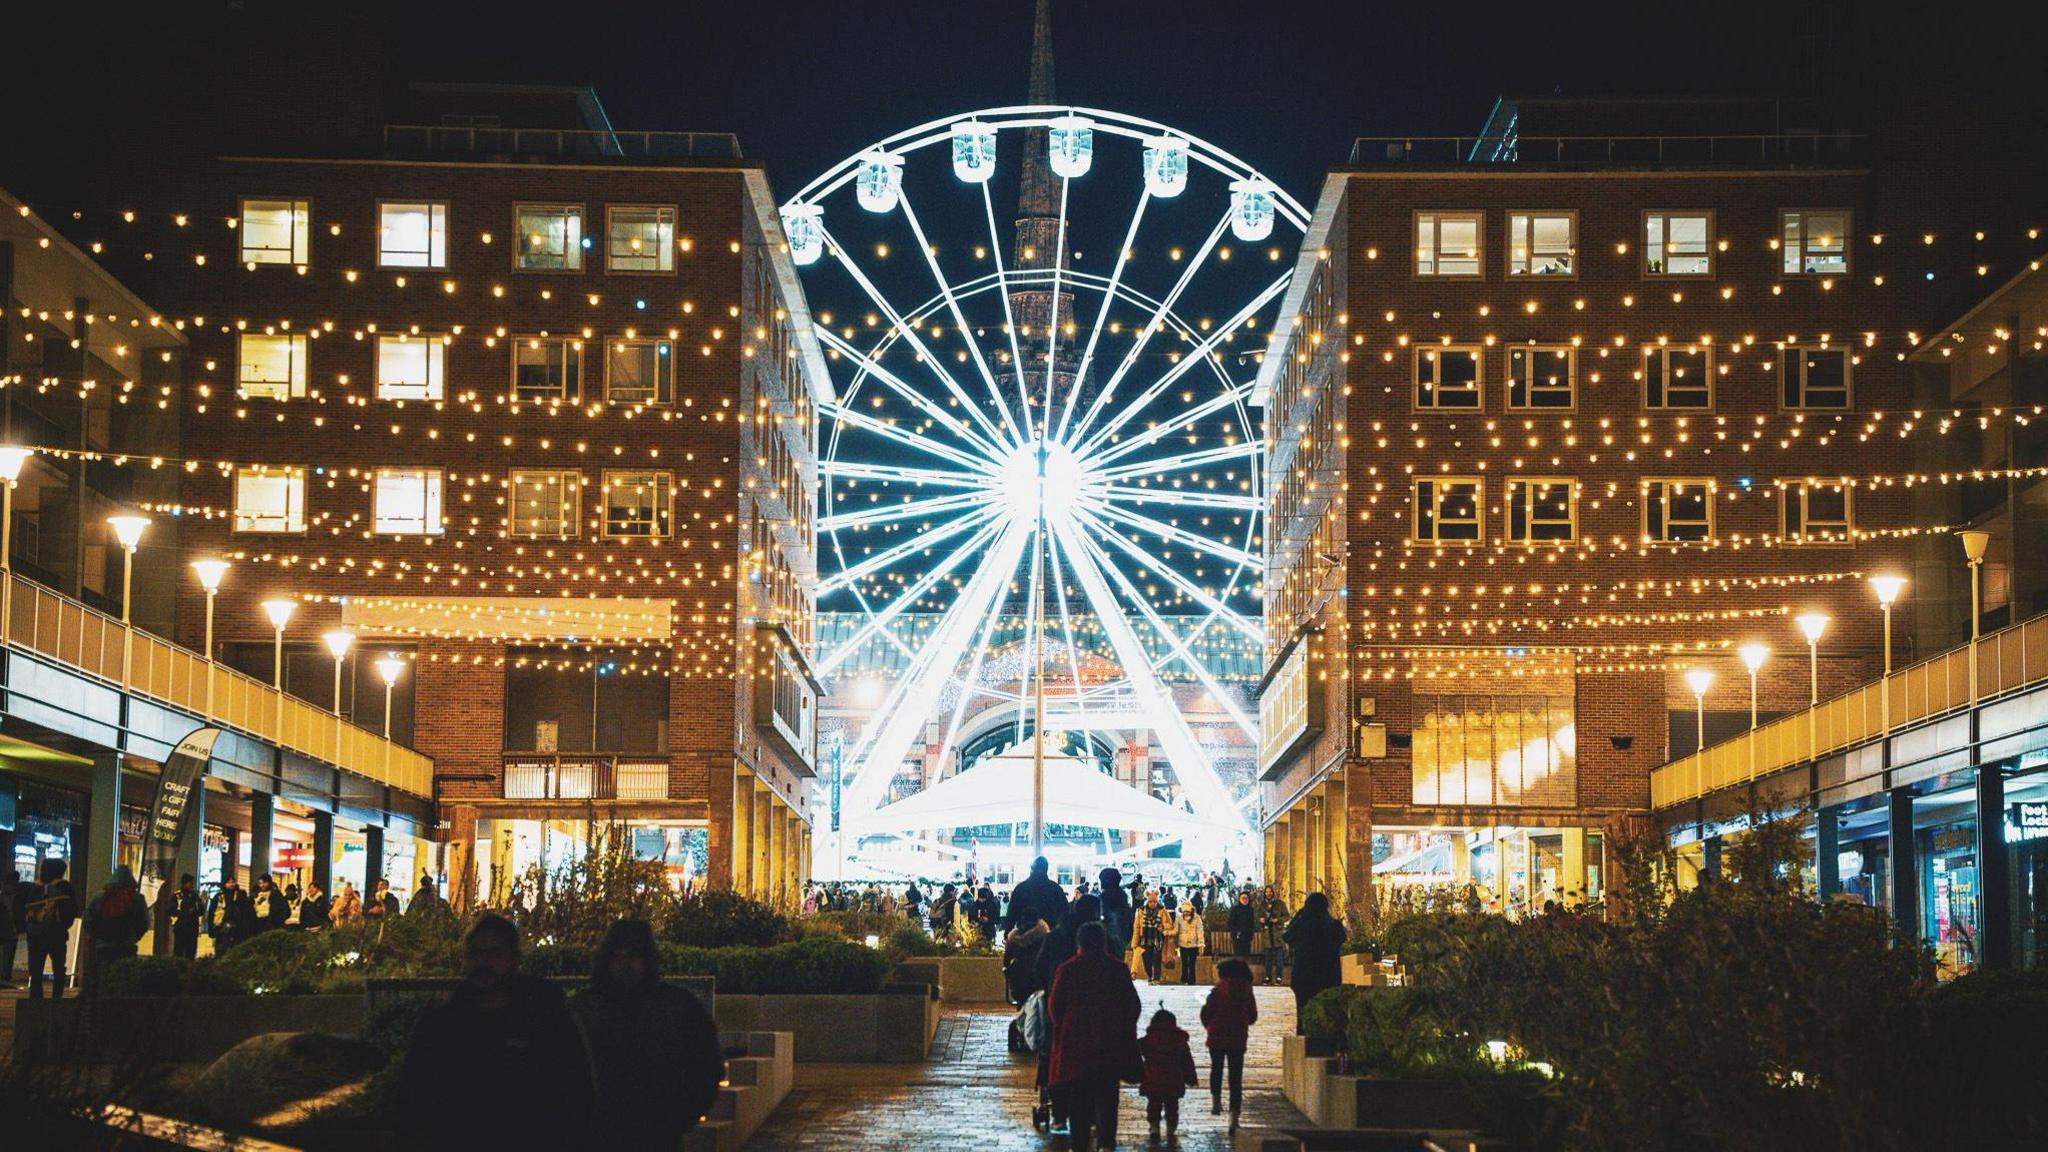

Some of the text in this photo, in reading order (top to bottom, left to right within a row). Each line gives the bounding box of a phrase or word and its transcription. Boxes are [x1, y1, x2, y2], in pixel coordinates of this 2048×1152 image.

[181, 743, 209, 756] JOIN US
[164, 781, 191, 795] CRAFT
[168, 795, 187, 807] GIFT
[161, 806, 180, 818] FAIR
[155, 818, 177, 830] HERE
[153, 829, 176, 842] TODAY
